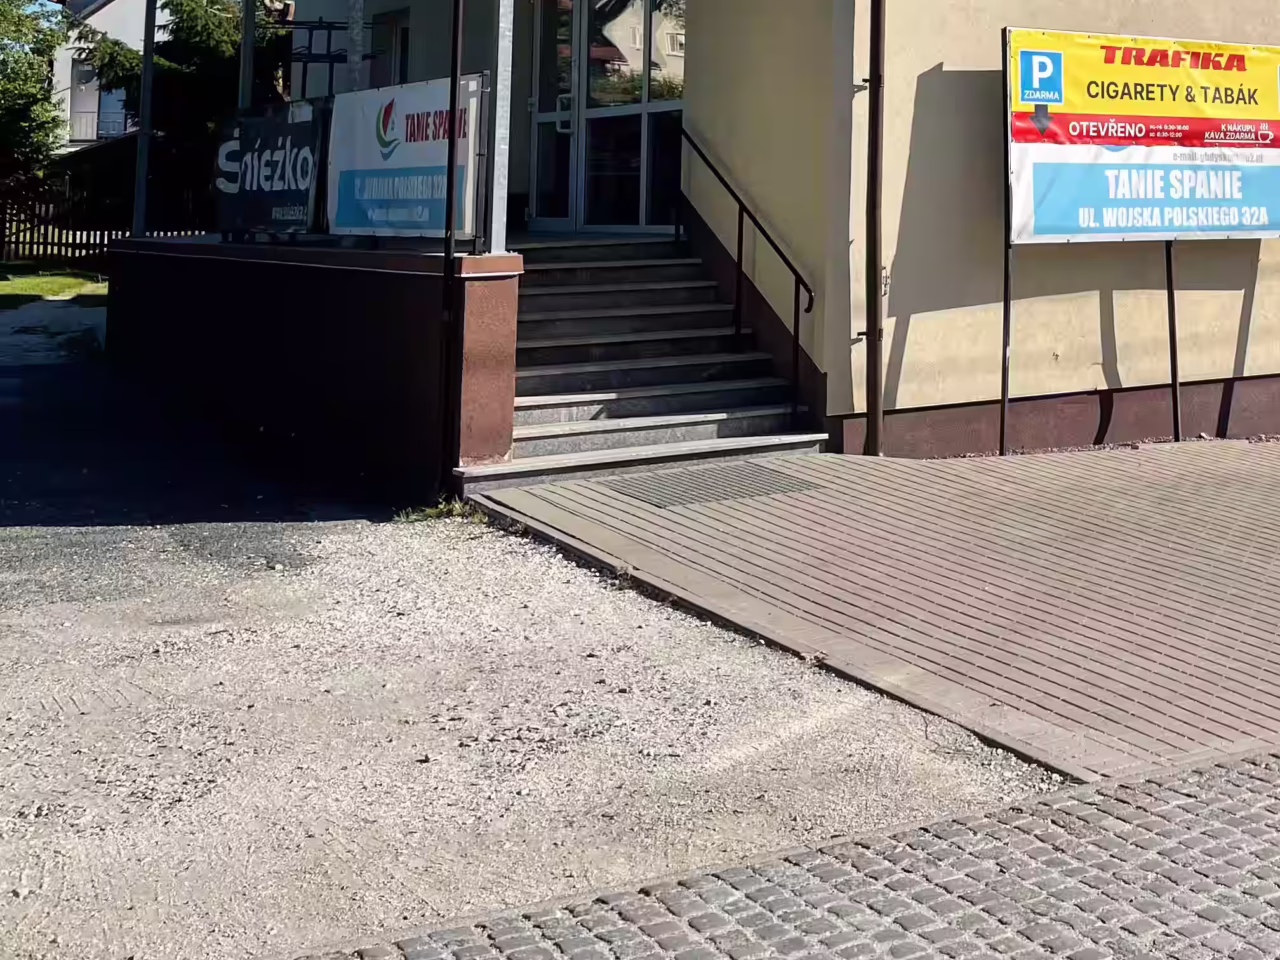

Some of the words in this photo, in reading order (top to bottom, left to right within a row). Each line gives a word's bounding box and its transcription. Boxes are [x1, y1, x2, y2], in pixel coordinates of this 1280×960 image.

[1100, 45, 1247, 72] TRAFIKA
[1032, 55, 1054, 89] P
[1024, 90, 1060, 101] ZDARMA
[1086, 80, 1180, 103] CIGARETY
[1185, 85, 1196, 103] &
[1200, 83, 1259, 106] TABÁK
[1068, 118, 1146, 138] OTEVŘENO
[1204, 130, 1225, 139] KÁVA
[1225, 132, 1256, 141] ZDARMA
[1221, 123, 1227, 132] K
[1227, 122, 1256, 133] NÁKUPU
[1105, 169, 1165, 199] TANIE
[1169, 169, 1243, 200] SPANIE
[1078, 207, 1100, 228] UL.
[1102, 206, 1162, 228] WOJSKA
[1164, 206, 1239, 227] POLSKIEGO
[1241, 206, 1269, 226] 32A
